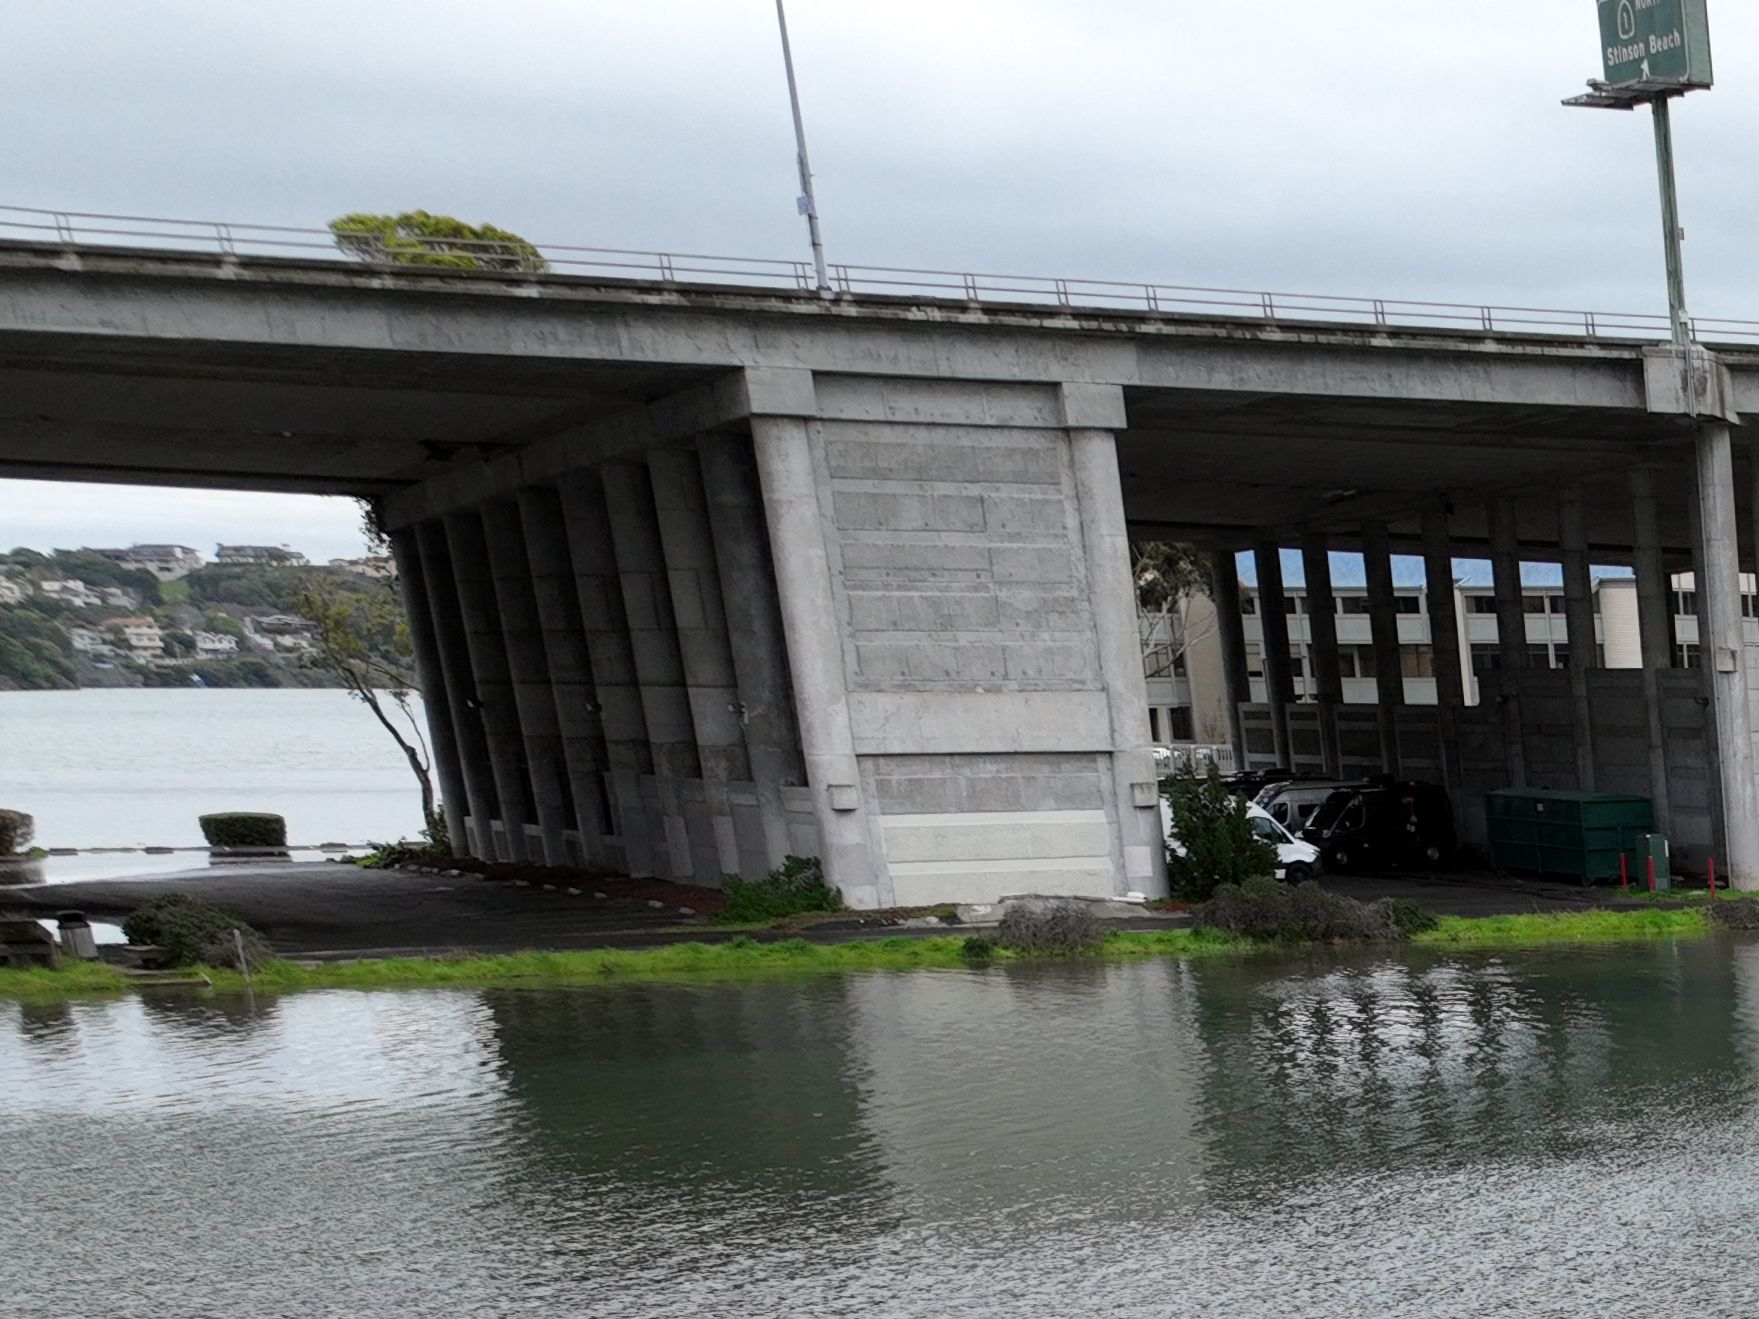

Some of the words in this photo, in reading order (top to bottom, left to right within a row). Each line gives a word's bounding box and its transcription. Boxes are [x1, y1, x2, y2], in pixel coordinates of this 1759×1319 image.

[1623, 11, 1629, 30] 1
[1607, 41, 1646, 66] Stinson
[1648, 27, 1681, 54] Beach
